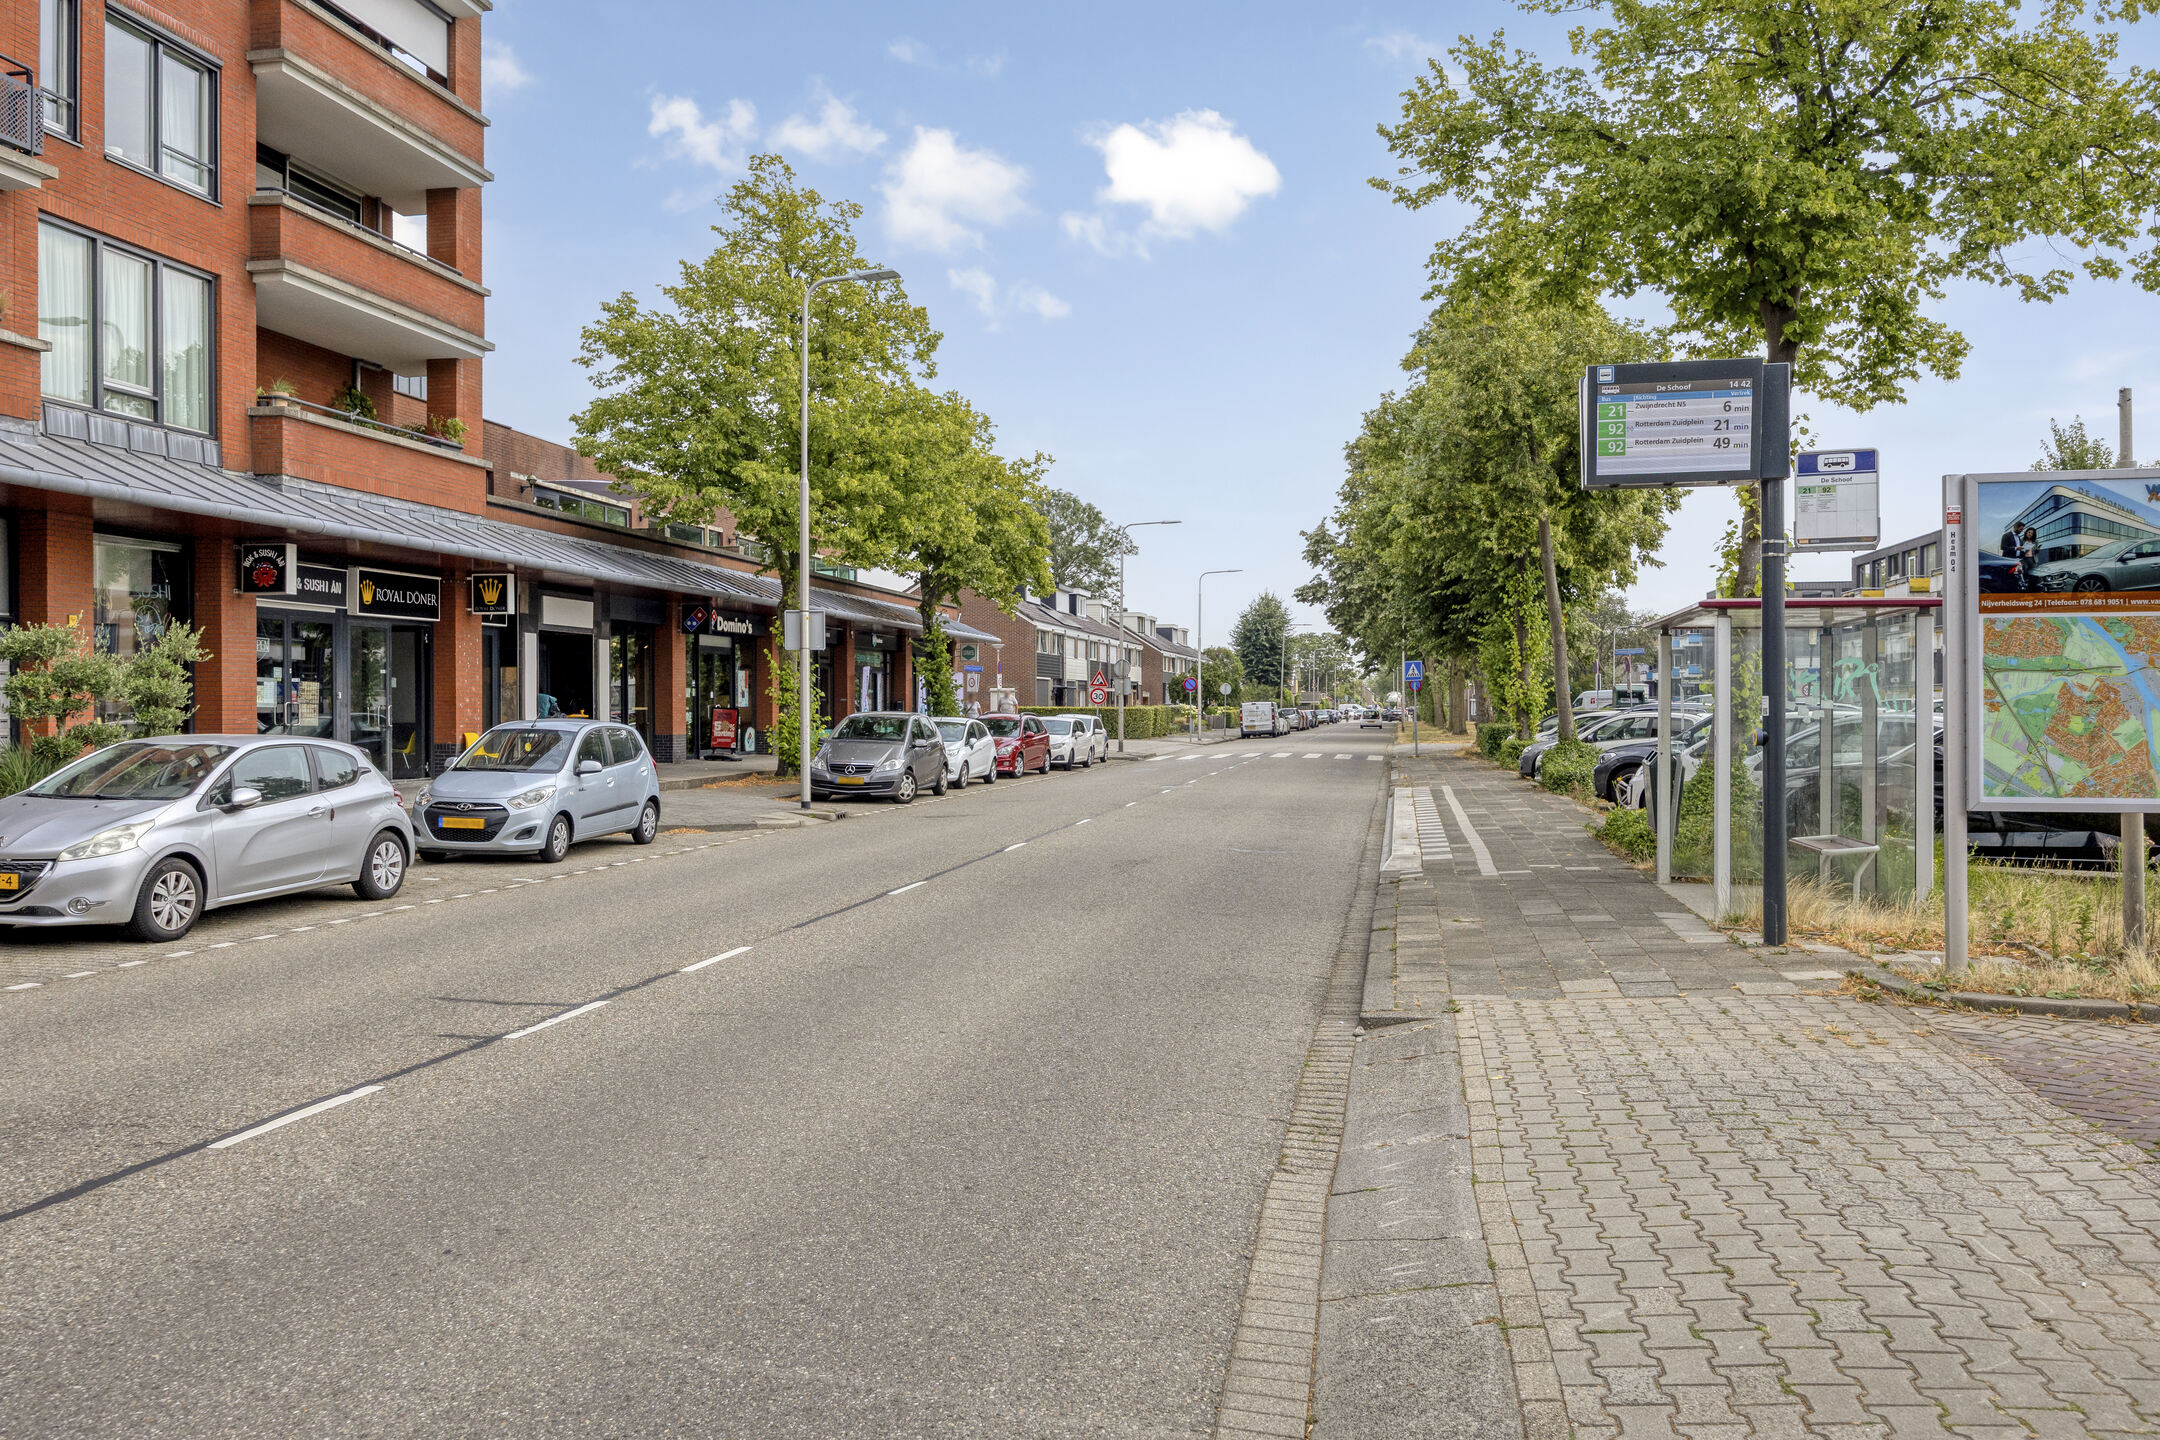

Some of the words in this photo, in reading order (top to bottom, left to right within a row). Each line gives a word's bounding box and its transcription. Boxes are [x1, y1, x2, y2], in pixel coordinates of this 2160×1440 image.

[1667, 383, 1692, 391] Schoof
[1608, 405, 1624, 417] 21
[1635, 401, 1675, 410] Zwijndrecht
[1723, 401, 1731, 412] 6
[1608, 423, 1624, 435] 92
[1635, 420, 1671, 428] Rotterdam
[1671, 418, 1704, 427] Zuidplein
[1713, 419, 1730, 431] 21
[1608, 441, 1624, 453] 92
[1634, 438, 1670, 446] Rotterdam
[1671, 436, 1704, 445] Zuidplein
[1713, 437, 1731, 449] 49
[258, 549, 278, 559] SUSHI
[304, 578, 329, 593] SUSHI
[376, 588, 405, 603] ROYAL
[1981, 600, 2033, 608] Nijverheidsweg
[717, 616, 753, 634] Domino's
[1093, 692, 1104, 700] 30
